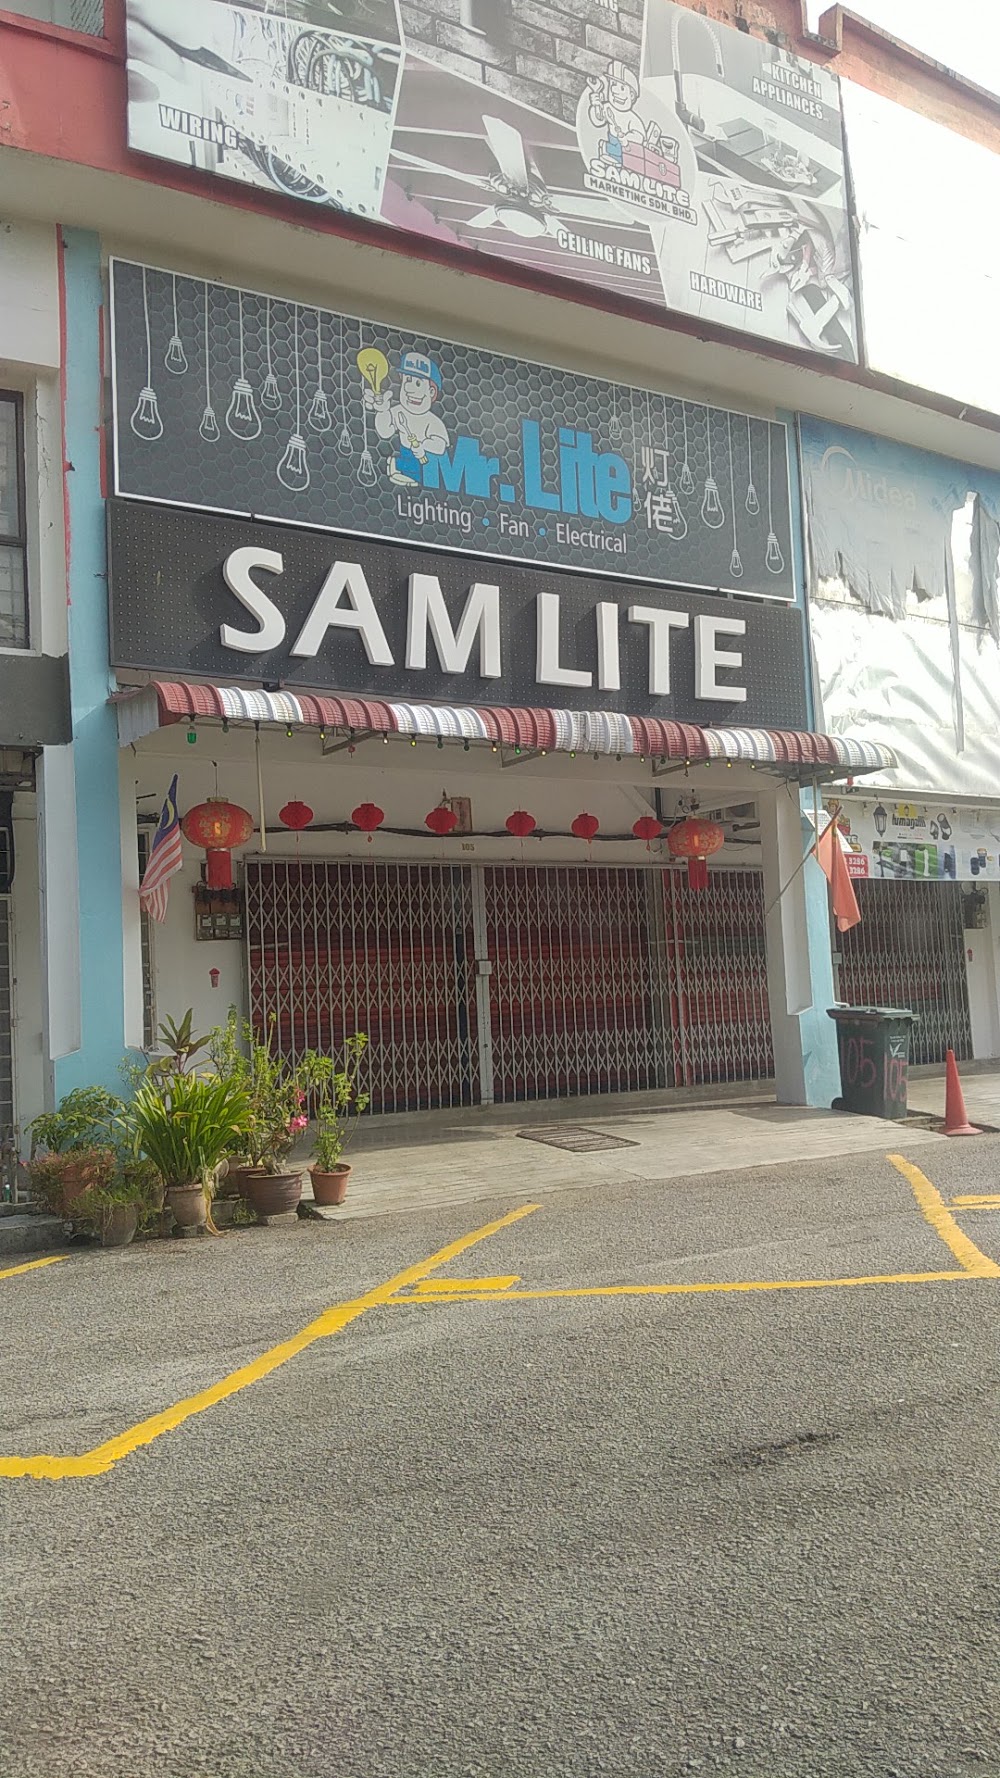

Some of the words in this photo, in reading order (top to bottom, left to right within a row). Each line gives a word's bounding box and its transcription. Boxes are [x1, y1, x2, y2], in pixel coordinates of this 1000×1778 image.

[753, 77, 823, 120] APPLIANCES
[772, 63, 822, 99] KITCHEN
[158, 104, 238, 149] WIRING
[590, 177, 647, 205] MARKETING
[649, 198, 670, 214] SDN.
[672, 204, 694, 222] BHD.
[558, 229, 614, 264] CEILING
[616, 248, 651, 275] FANS
[690, 271, 762, 311] HARDWARE
[397, 494, 471, 533] Lighting
[500, 513, 529, 538] Fan
[556, 523, 627, 553] Electrical
[220, 546, 501, 678] SAM
[536, 592, 747, 701] LITE
[841, 1036, 877, 1088] 105
